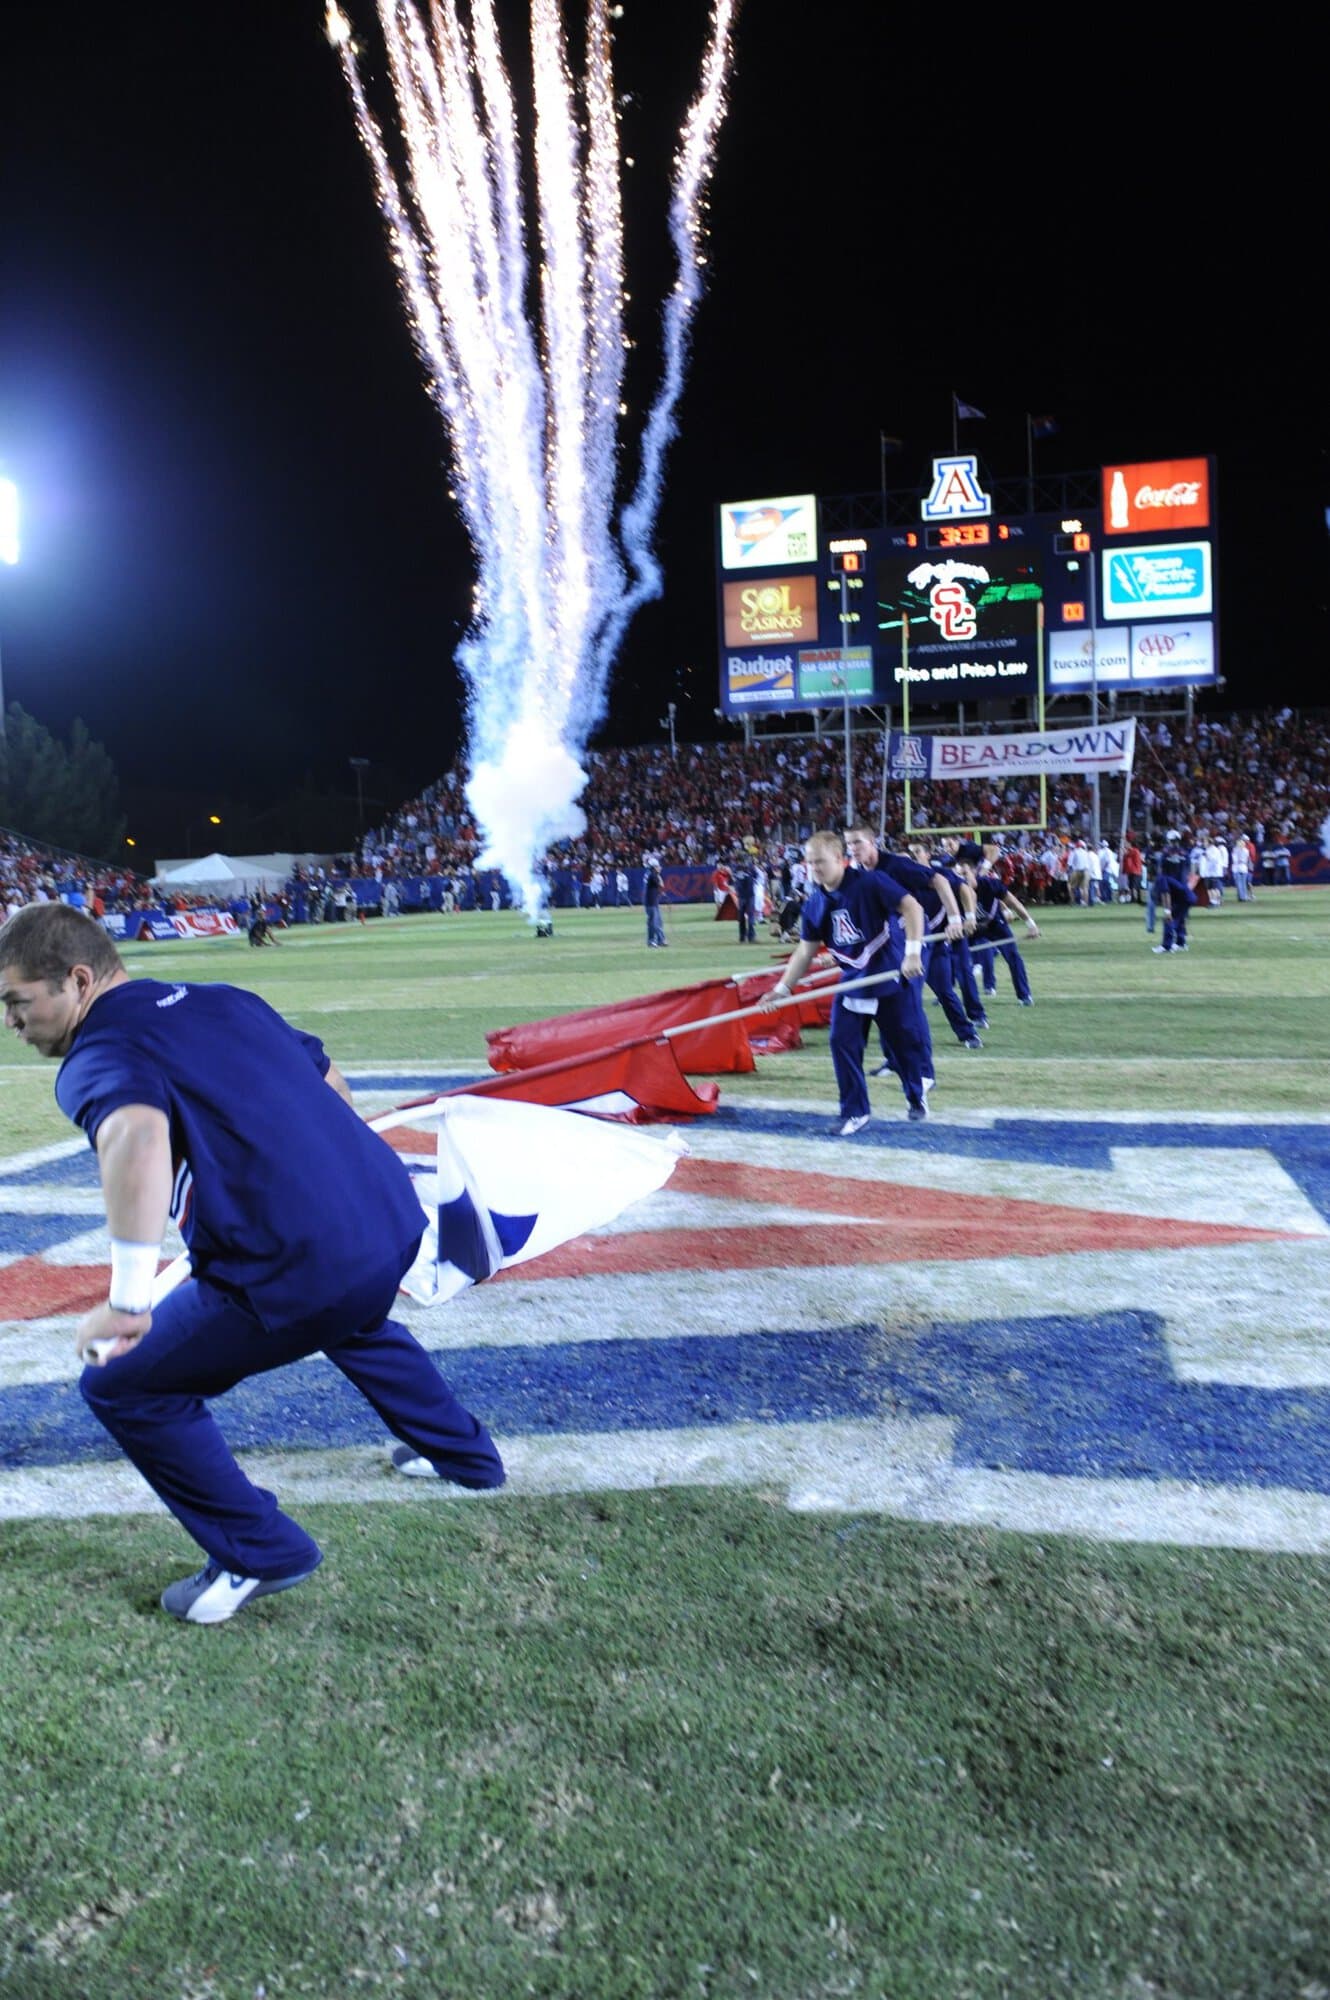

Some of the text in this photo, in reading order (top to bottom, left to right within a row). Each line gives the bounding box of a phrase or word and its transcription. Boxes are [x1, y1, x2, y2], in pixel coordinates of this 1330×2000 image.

[921, 455, 992, 522] A
[740, 585, 802, 619] SOL
[740, 615, 803, 633] CASINOS
[728, 654, 794, 680] Budget
[931, 663, 958, 680] and
[998, 660, 1028, 677] Law
[892, 736, 927, 768] A
[831, 909, 866, 946] A
